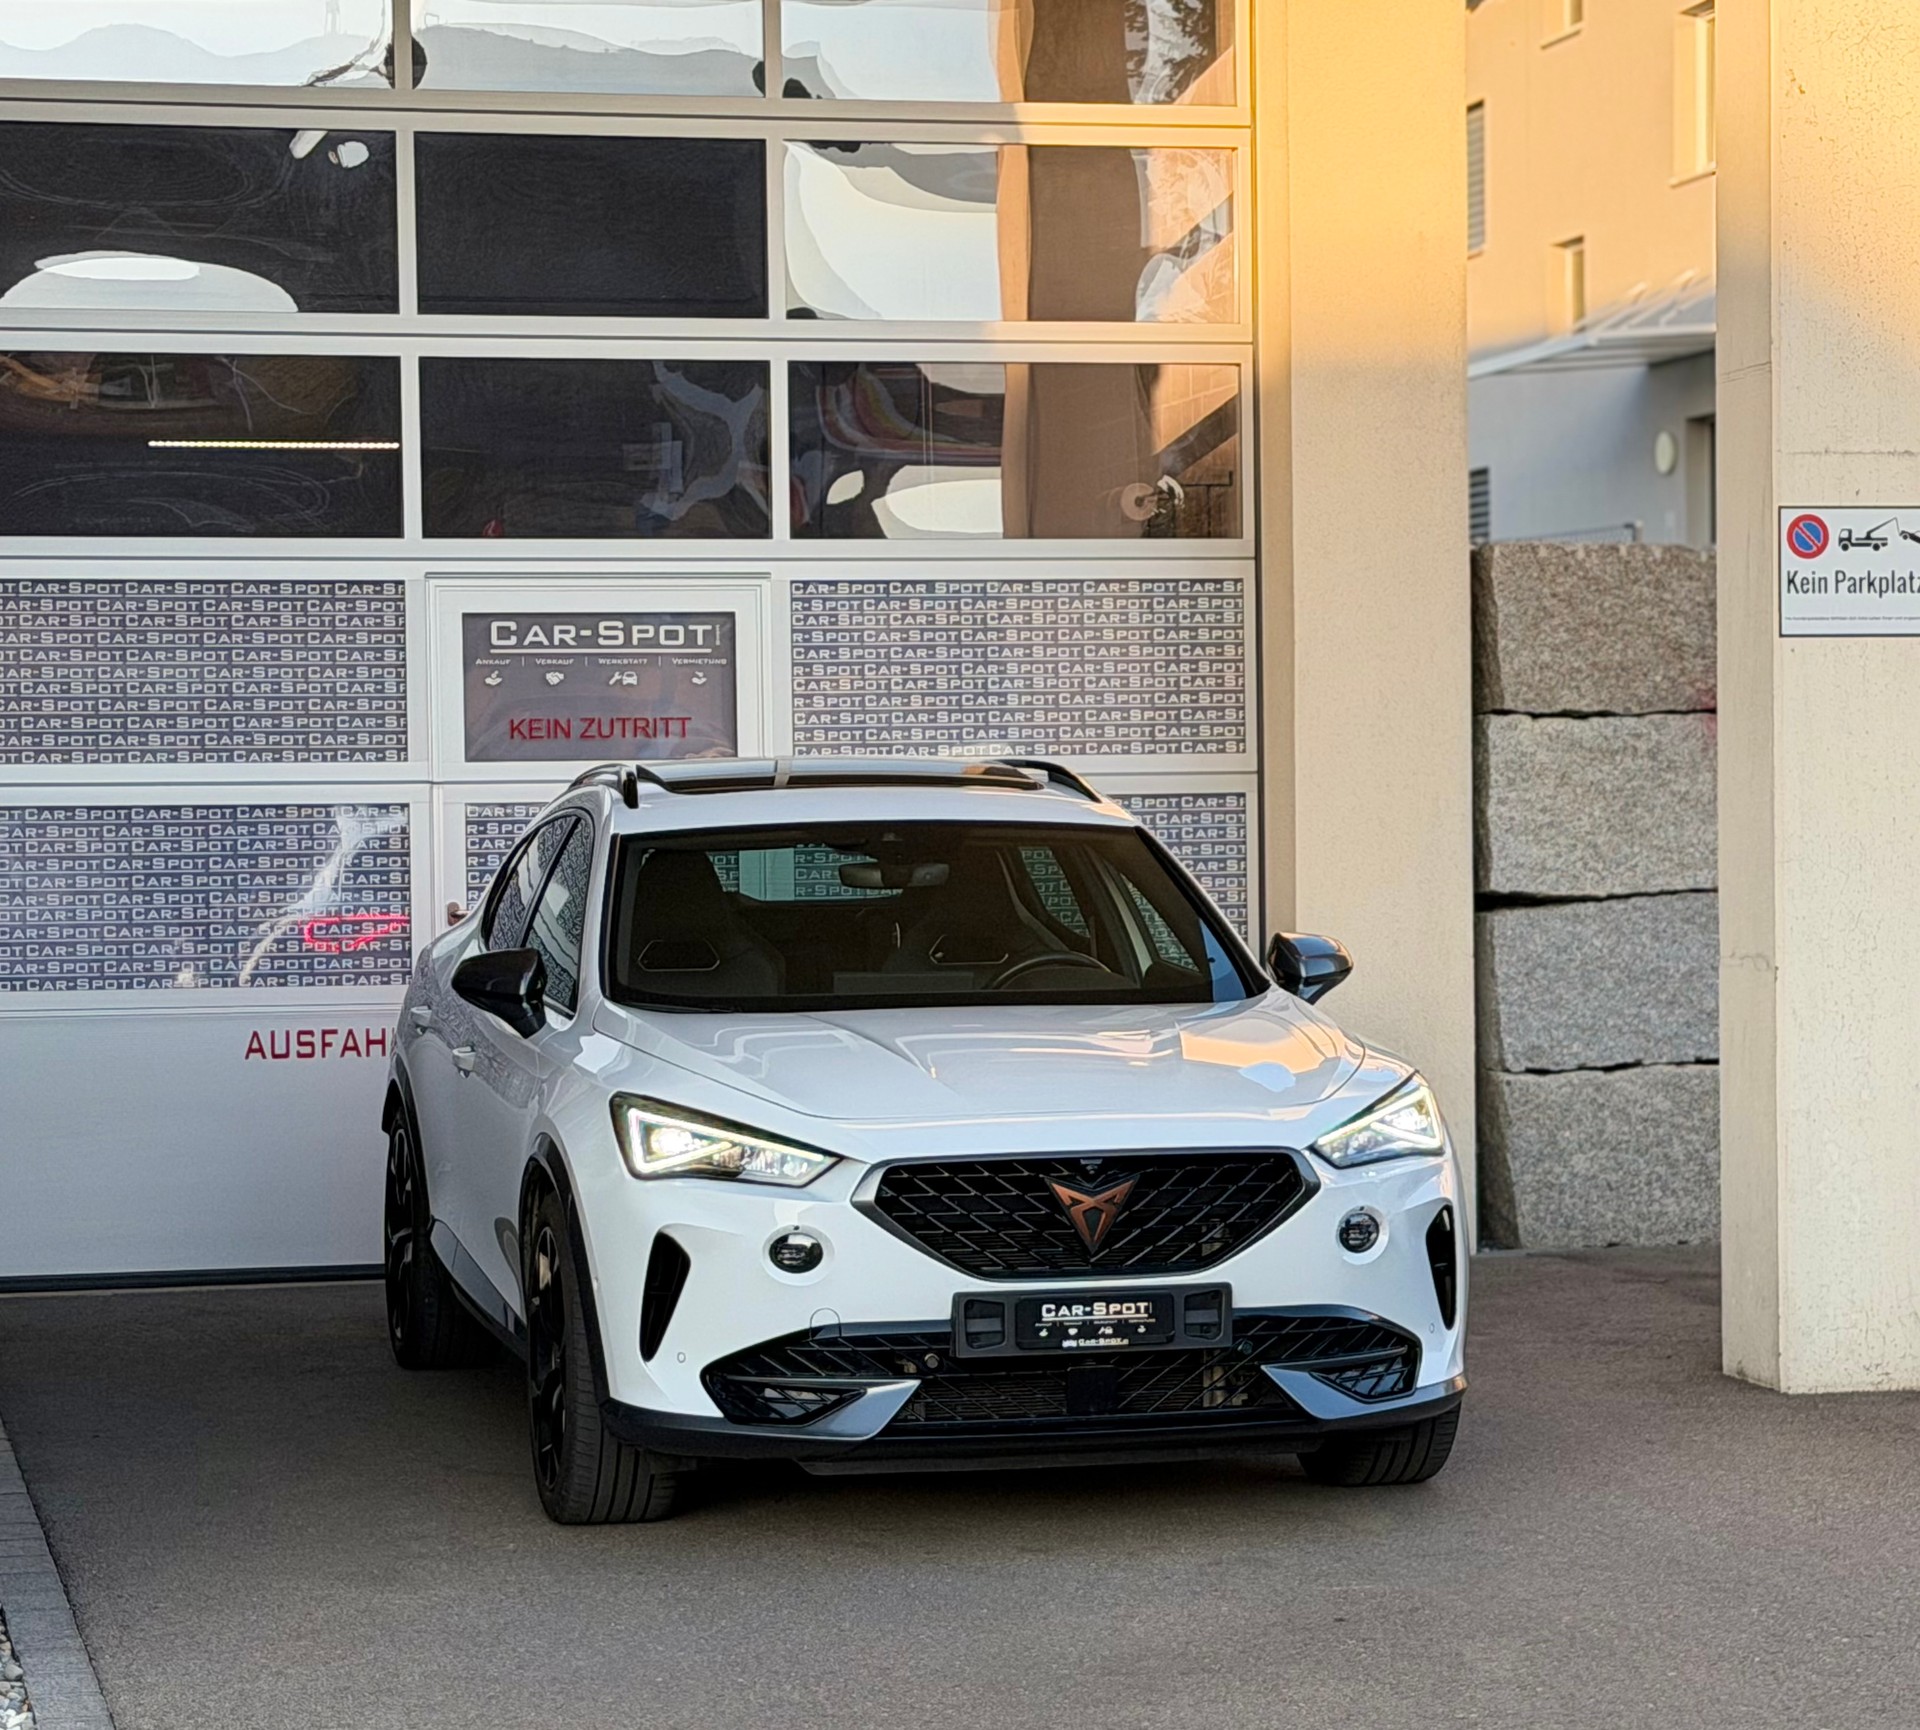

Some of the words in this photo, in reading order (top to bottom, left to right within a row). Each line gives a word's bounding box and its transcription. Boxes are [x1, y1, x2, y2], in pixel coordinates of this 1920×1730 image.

[1787, 570, 1828, 594] Kein
[490, 620, 712, 646] CAR-SPOT
[509, 718, 572, 740] KEIN
[580, 717, 692, 739] ZUTRITT
[245, 1028, 396, 1060] AUSFAH
[1042, 1302, 1148, 1318] CAR-SPOT
